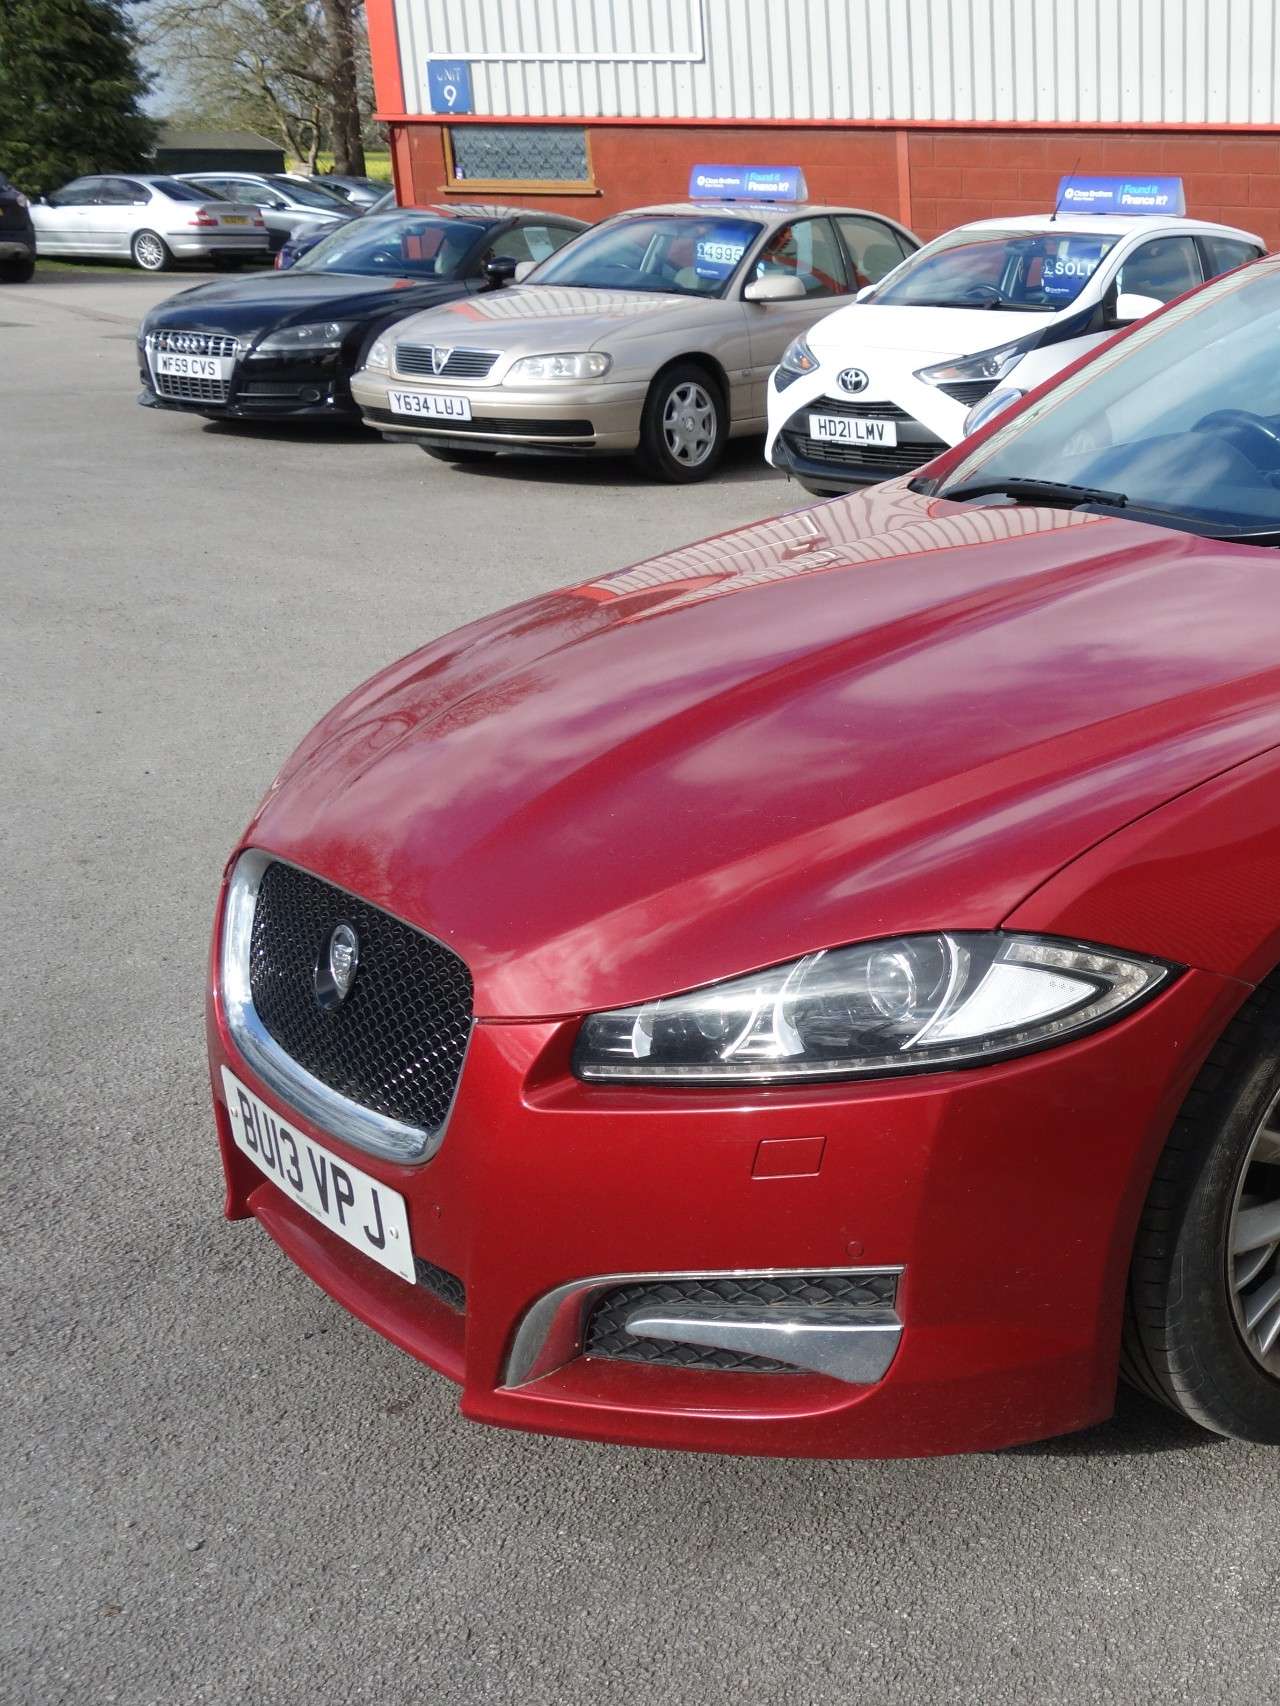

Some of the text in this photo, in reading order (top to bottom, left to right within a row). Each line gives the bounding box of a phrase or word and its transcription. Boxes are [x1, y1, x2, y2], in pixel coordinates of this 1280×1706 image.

[443, 84, 457, 107] 9
[1124, 184, 1151, 194] Found
[1121, 194, 1155, 205] Finance
[191, 359, 216, 376] CVS
[394, 393, 430, 413] Y634
[818, 418, 885, 441] HD21 LMV
[236, 1087, 386, 1250] BU13 VPJ
